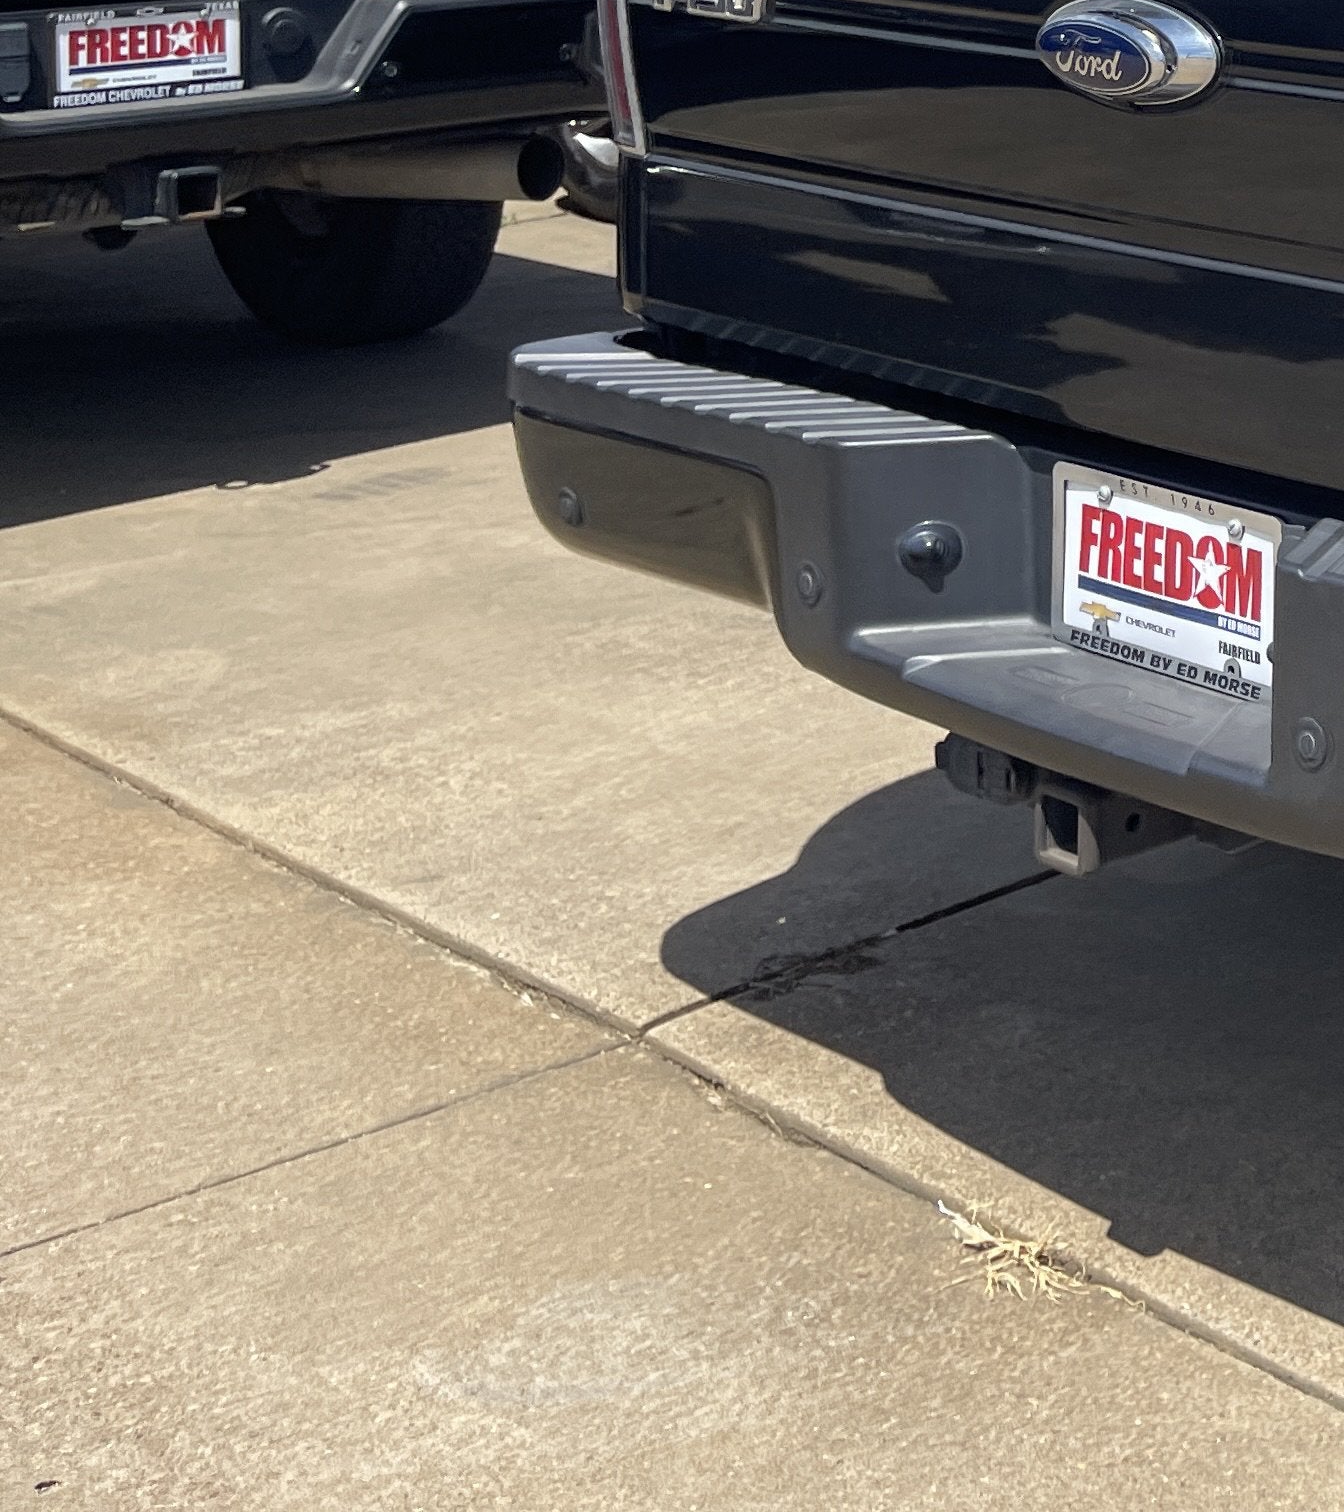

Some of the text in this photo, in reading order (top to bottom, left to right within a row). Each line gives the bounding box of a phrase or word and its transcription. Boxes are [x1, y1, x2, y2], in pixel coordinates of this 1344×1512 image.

[69, 19, 227, 66] FREEDOM
[1055, 29, 1123, 81] Ford
[54, 92, 106, 108] FREEDOM
[109, 85, 171, 102] CHEVROLET
[1170, 494, 1215, 516] 1946
[1078, 503, 1263, 622] FREEDOM
[1126, 616, 1176, 638] CHEVROLET
[1070, 629, 1262, 700] FREEDOM BY ED MORSE
[1218, 640, 1261, 665] FAIRFIELD
